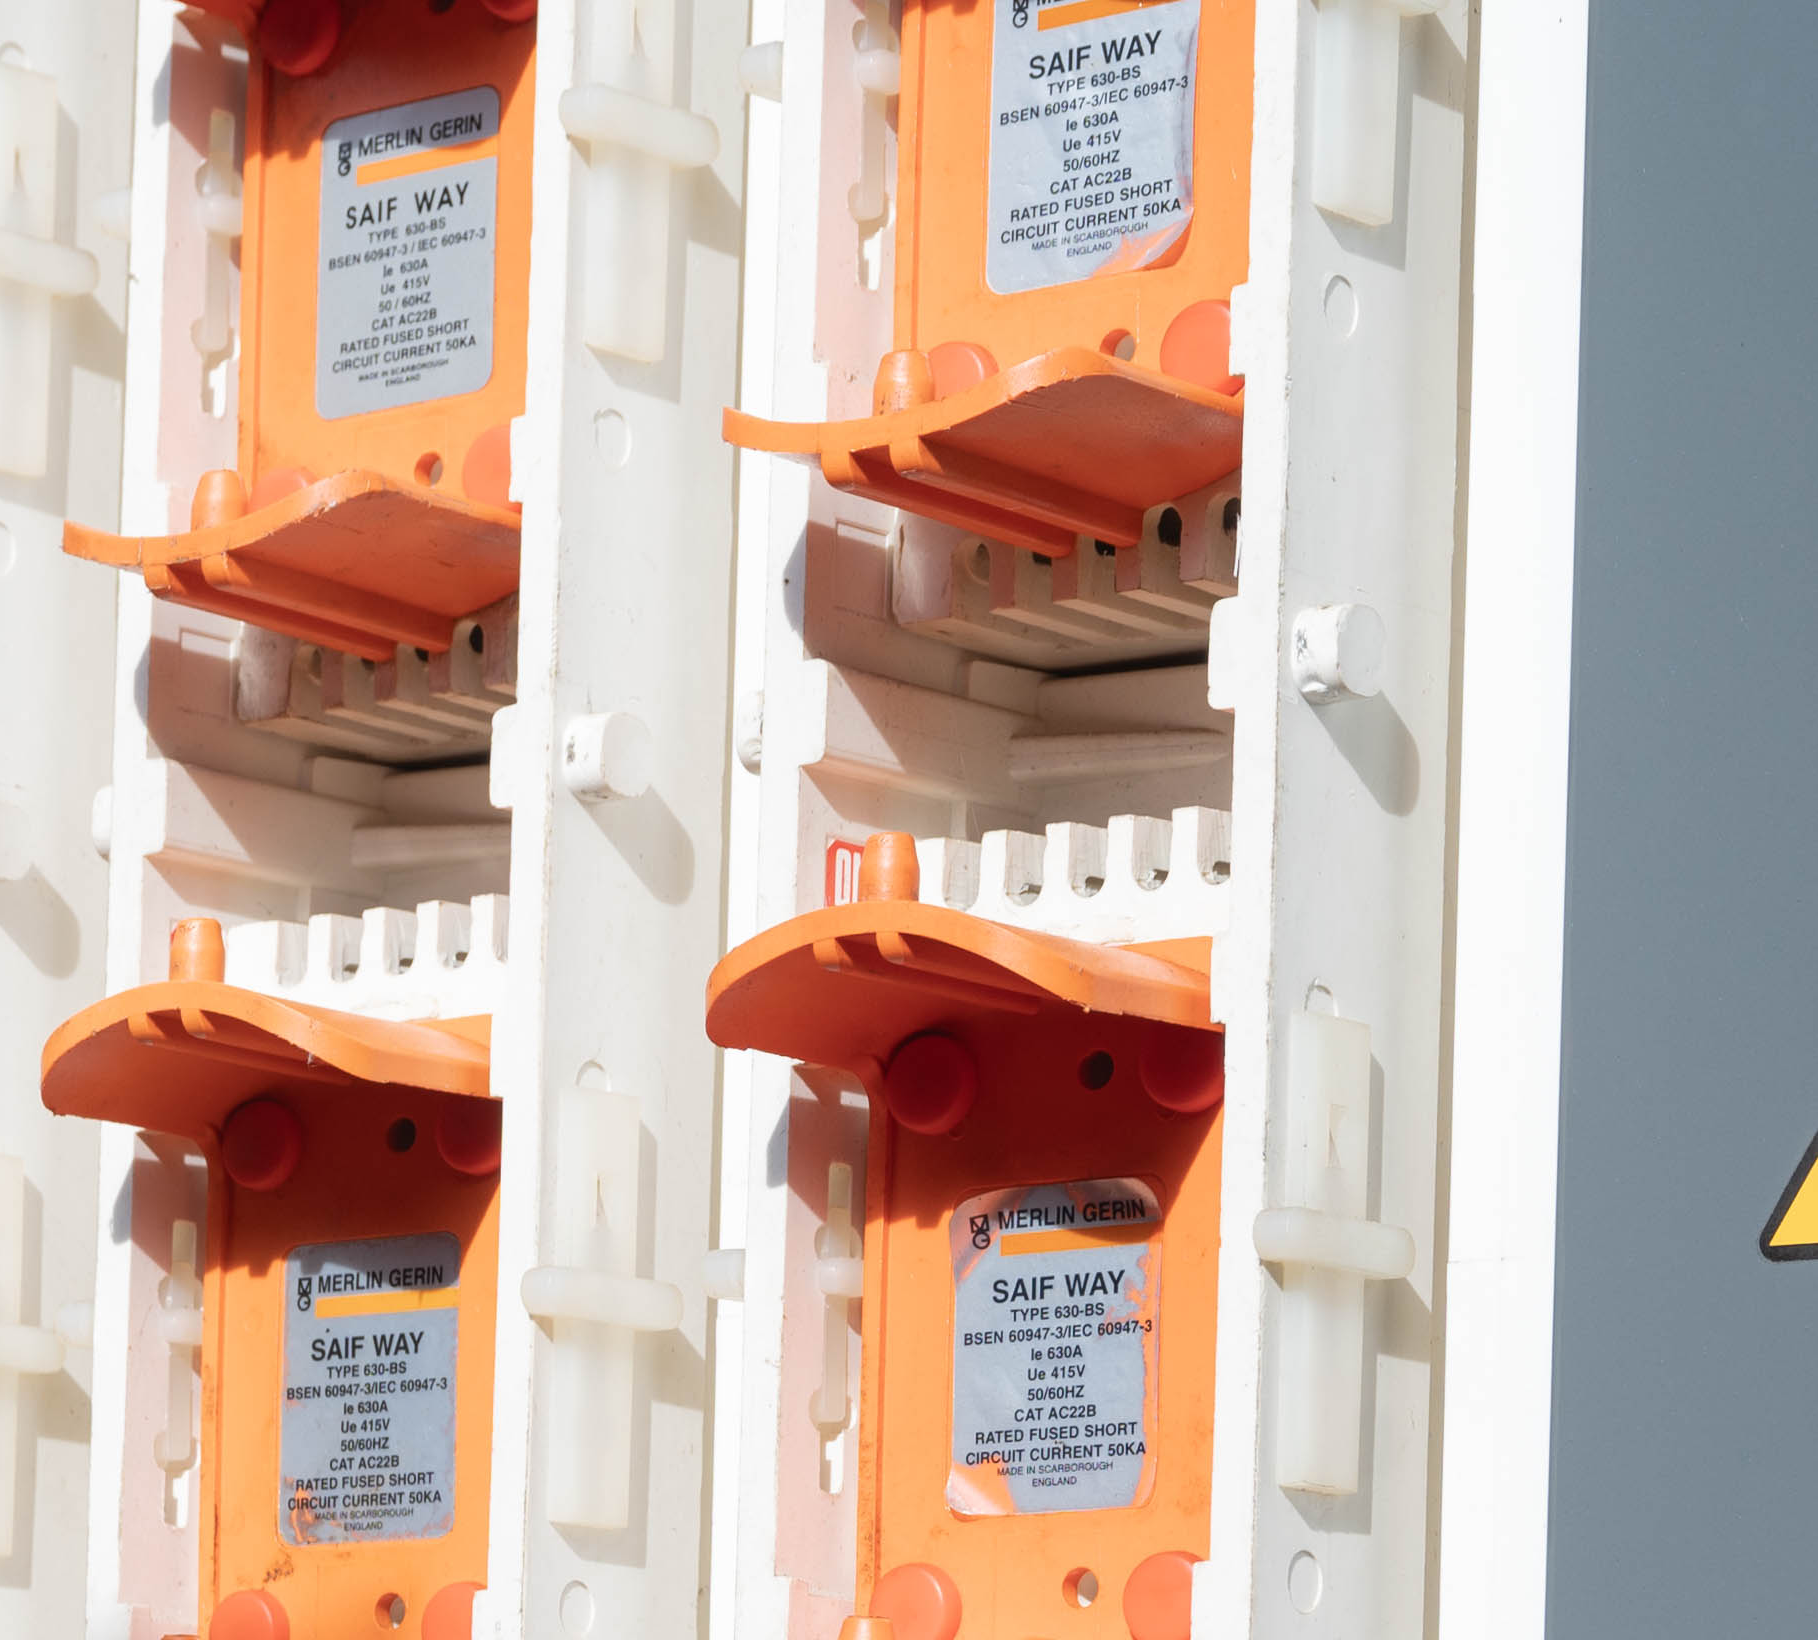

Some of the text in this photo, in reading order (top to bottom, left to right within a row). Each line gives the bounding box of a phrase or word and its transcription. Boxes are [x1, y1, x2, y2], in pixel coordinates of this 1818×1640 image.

[1029, 29, 1161, 79] SAIF WAY
[1047, 65, 1140, 95] TYPE 630-BS
[1000, 75, 1187, 125] BSEN 60947-3/IEC 60947-3
[1066, 110, 1118, 131] Ie 630A
[358, 112, 482, 156] MERLIN GERIN
[1063, 128, 1121, 152] Ue 415V
[1063, 149, 1119, 172] 50/60HZ
[1050, 167, 1131, 194] CAT AC22B
[345, 181, 468, 229] SAIF WAY
[1010, 178, 1172, 222] RATED FUSED SHORT
[367, 216, 445, 244] TYPE 630-BS
[1000, 198, 1181, 243] CIRCUIT CURRENT 50KA
[1031, 221, 1148, 250] MADE IN SCARBOROUGH
[1066, 240, 1112, 257] ENGLAND
[382, 257, 428, 278] Ie 630A
[380, 274, 430, 295] Ue 415V
[371, 307, 436, 331] CAT AC22B
[340, 318, 469, 353] RATED FUSED SHORT
[332, 334, 476, 373] CIRCUIT CURRENT 50KA
[998, 1198, 1145, 1229] MERLIN GERIN
[318, 1265, 442, 1293] MERLIN GERIN
[992, 1269, 1124, 1303] SAIF WAY
[1010, 1302, 1104, 1321] TYPE 630-BS
[964, 1319, 1151, 1345] BSEN 60947-3/IEC 60947-3
[311, 1331, 423, 1361] SAIF WAY
[1031, 1344, 1082, 1360] Ie 630A
[326, 1360, 406, 1379] TYPE 630-BS
[1027, 1364, 1085, 1380] Ue 415V
[286, 1377, 447, 1399] BSEN 60947-3/IEC 60947-3
[1027, 1384, 1084, 1400] 50/60HZ
[343, 1399, 388, 1414] Ie 630A
[1014, 1404, 1096, 1421] CAT AC22B
[341, 1417, 390, 1433] Ue 415V
[975, 1421, 1137, 1444] RATED FUSED SHORT
[340, 1436, 389, 1452] 50/60HZ
[965, 1441, 1145, 1465] CIRCUIT CURRENT 50KA
[329, 1454, 399, 1471] CAT AC22B
[997, 1460, 1113, 1475] MADE IN SCARBOROUGH
[295, 1471, 434, 1491] RATED FUSED SHORT
[1032, 1475, 1077, 1487] ENGLAND
[287, 1489, 441, 1511] CIRCUIT CURRENT 50KA
[314, 1507, 413, 1520] MADE IN SCARBOROUGH
[343, 1520, 382, 1531] ENGLAND
